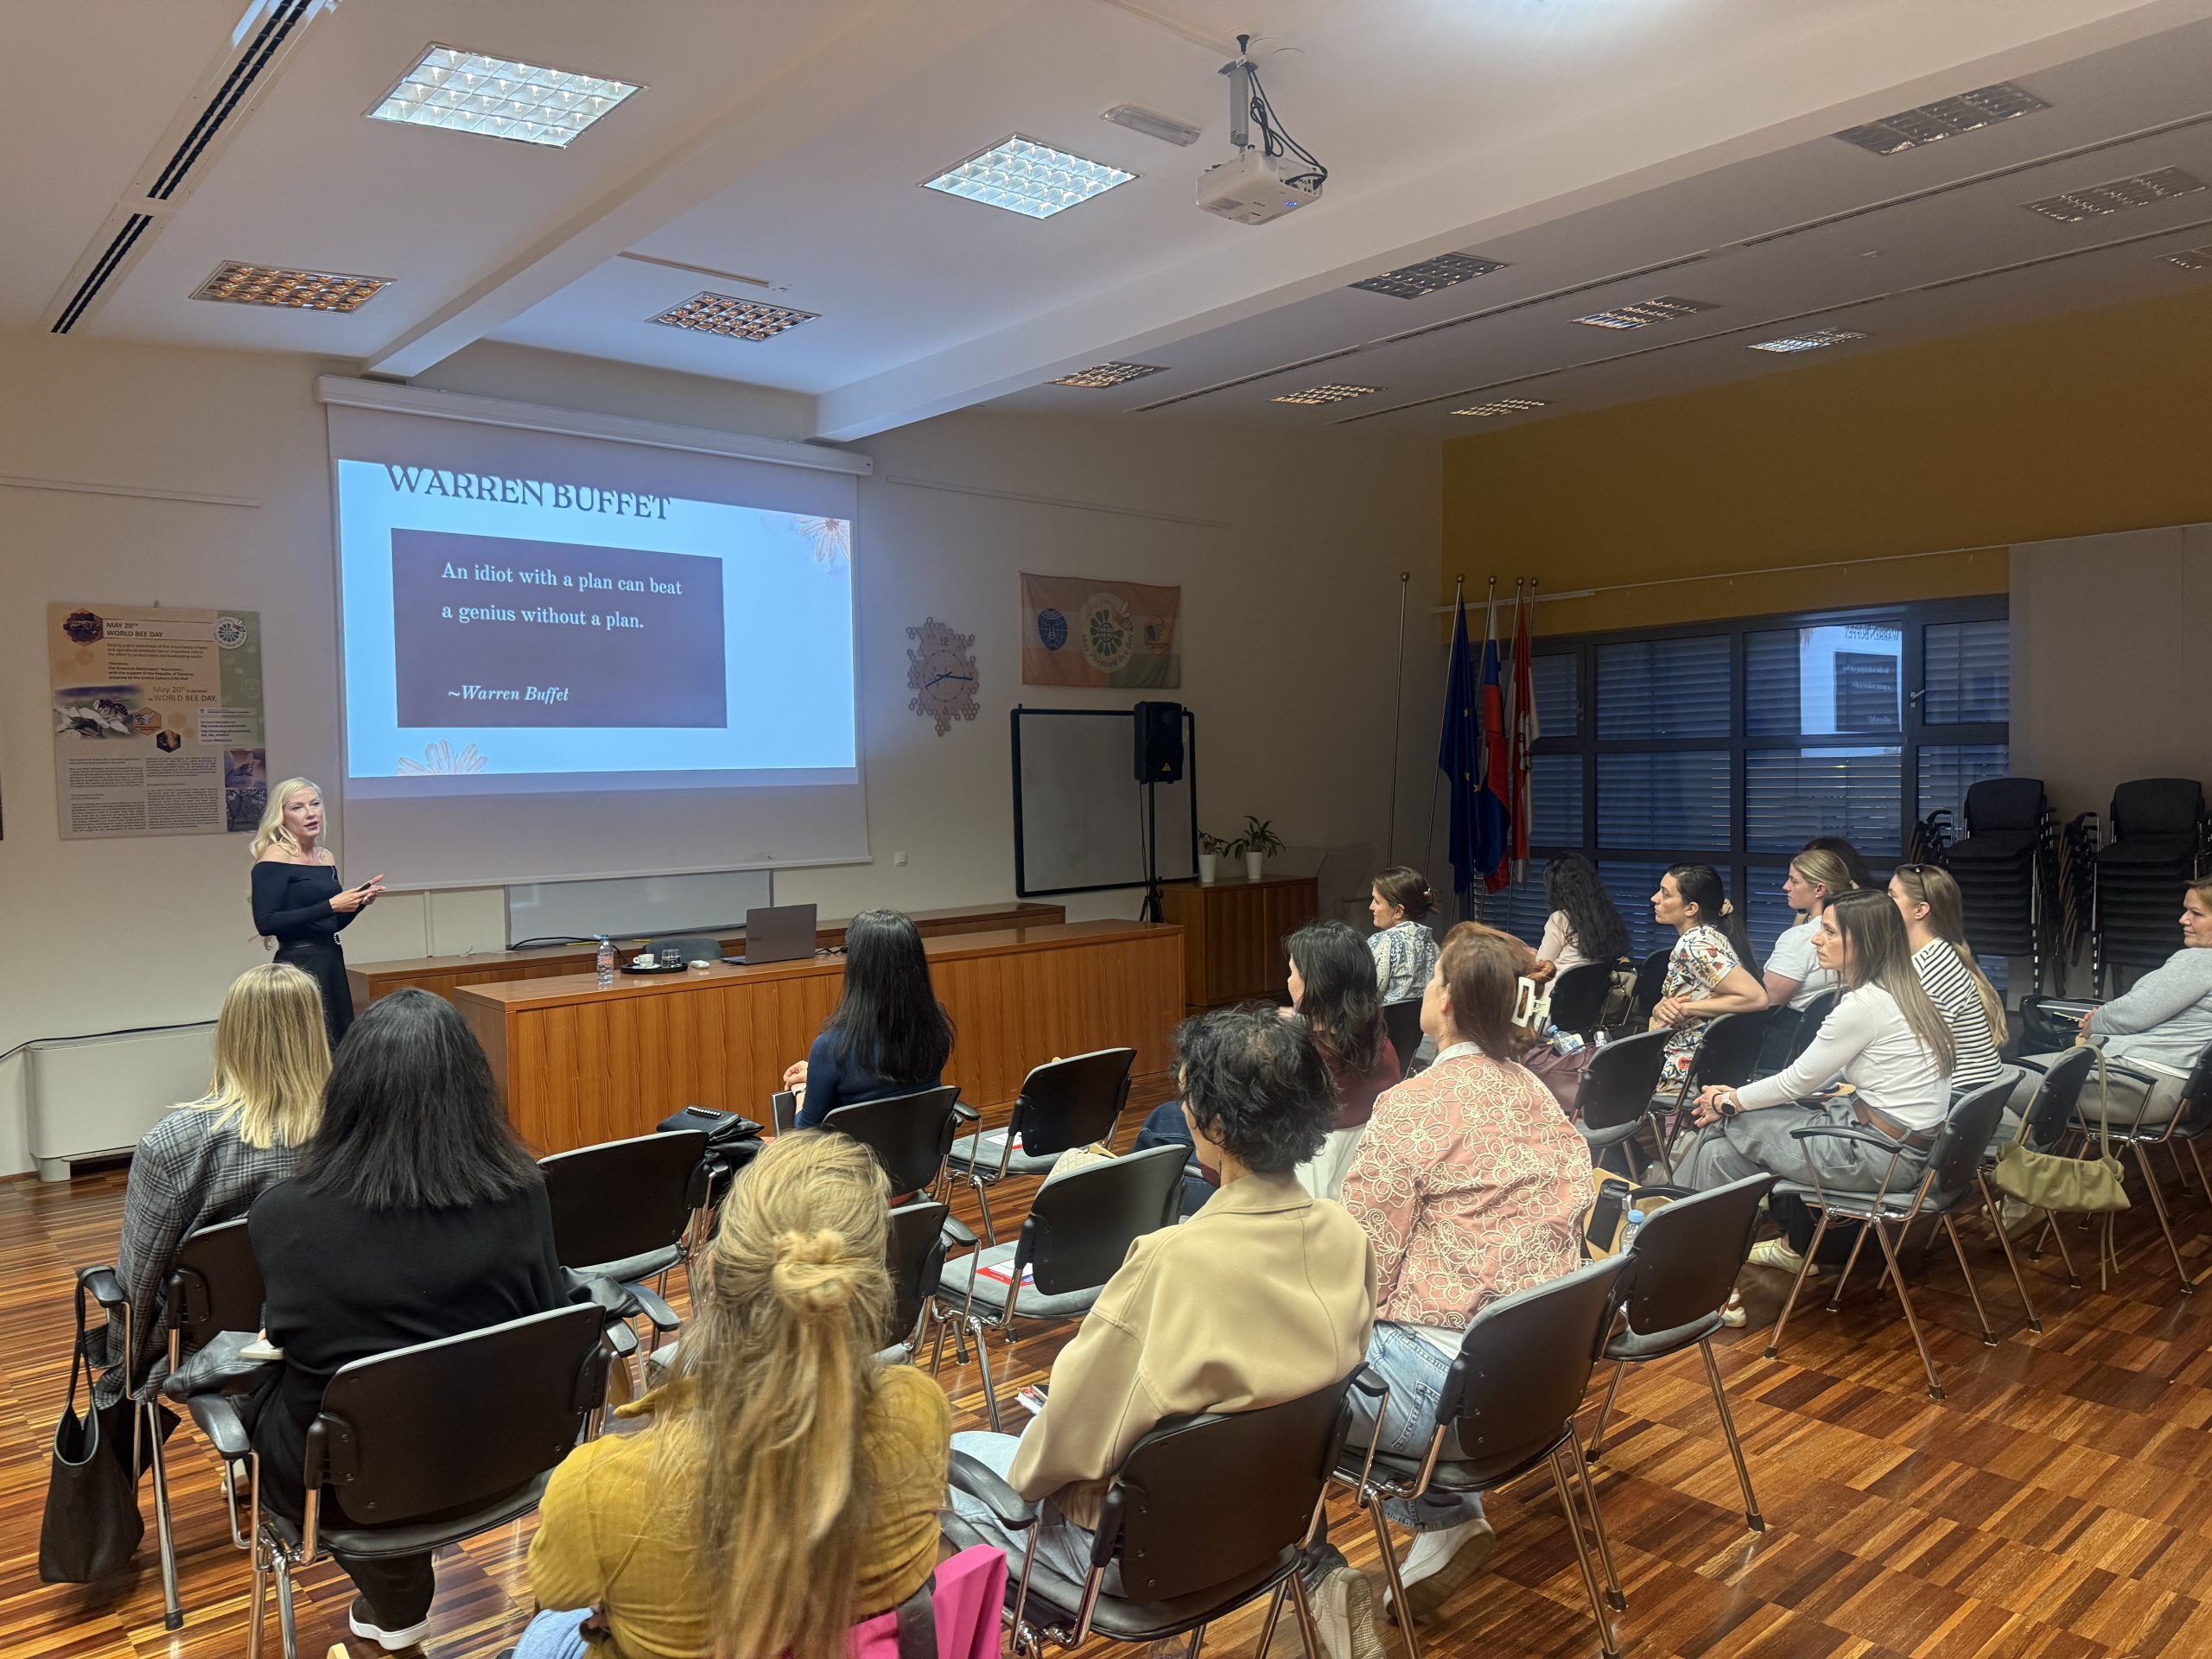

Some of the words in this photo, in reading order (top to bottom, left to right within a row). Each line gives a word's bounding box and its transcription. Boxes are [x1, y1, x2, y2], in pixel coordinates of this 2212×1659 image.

[385, 464, 543, 506] WARREN
[553, 483, 671, 520] BUFFET
[441, 562, 469, 580] An
[474, 564, 513, 582] idiot
[518, 569, 558, 586] with
[563, 574, 574, 588] a
[578, 572, 613, 592] plan
[618, 579, 645, 592] can
[650, 577, 683, 594] beat
[442, 606, 453, 619] a
[459, 605, 516, 624] genius
[521, 607, 587, 626] without
[591, 613, 601, 626] a
[606, 612, 644, 631] plan.
[940, 637, 949, 646] 12
[524, 686, 569, 704] Buffet
[943, 706, 949, 715] 6
